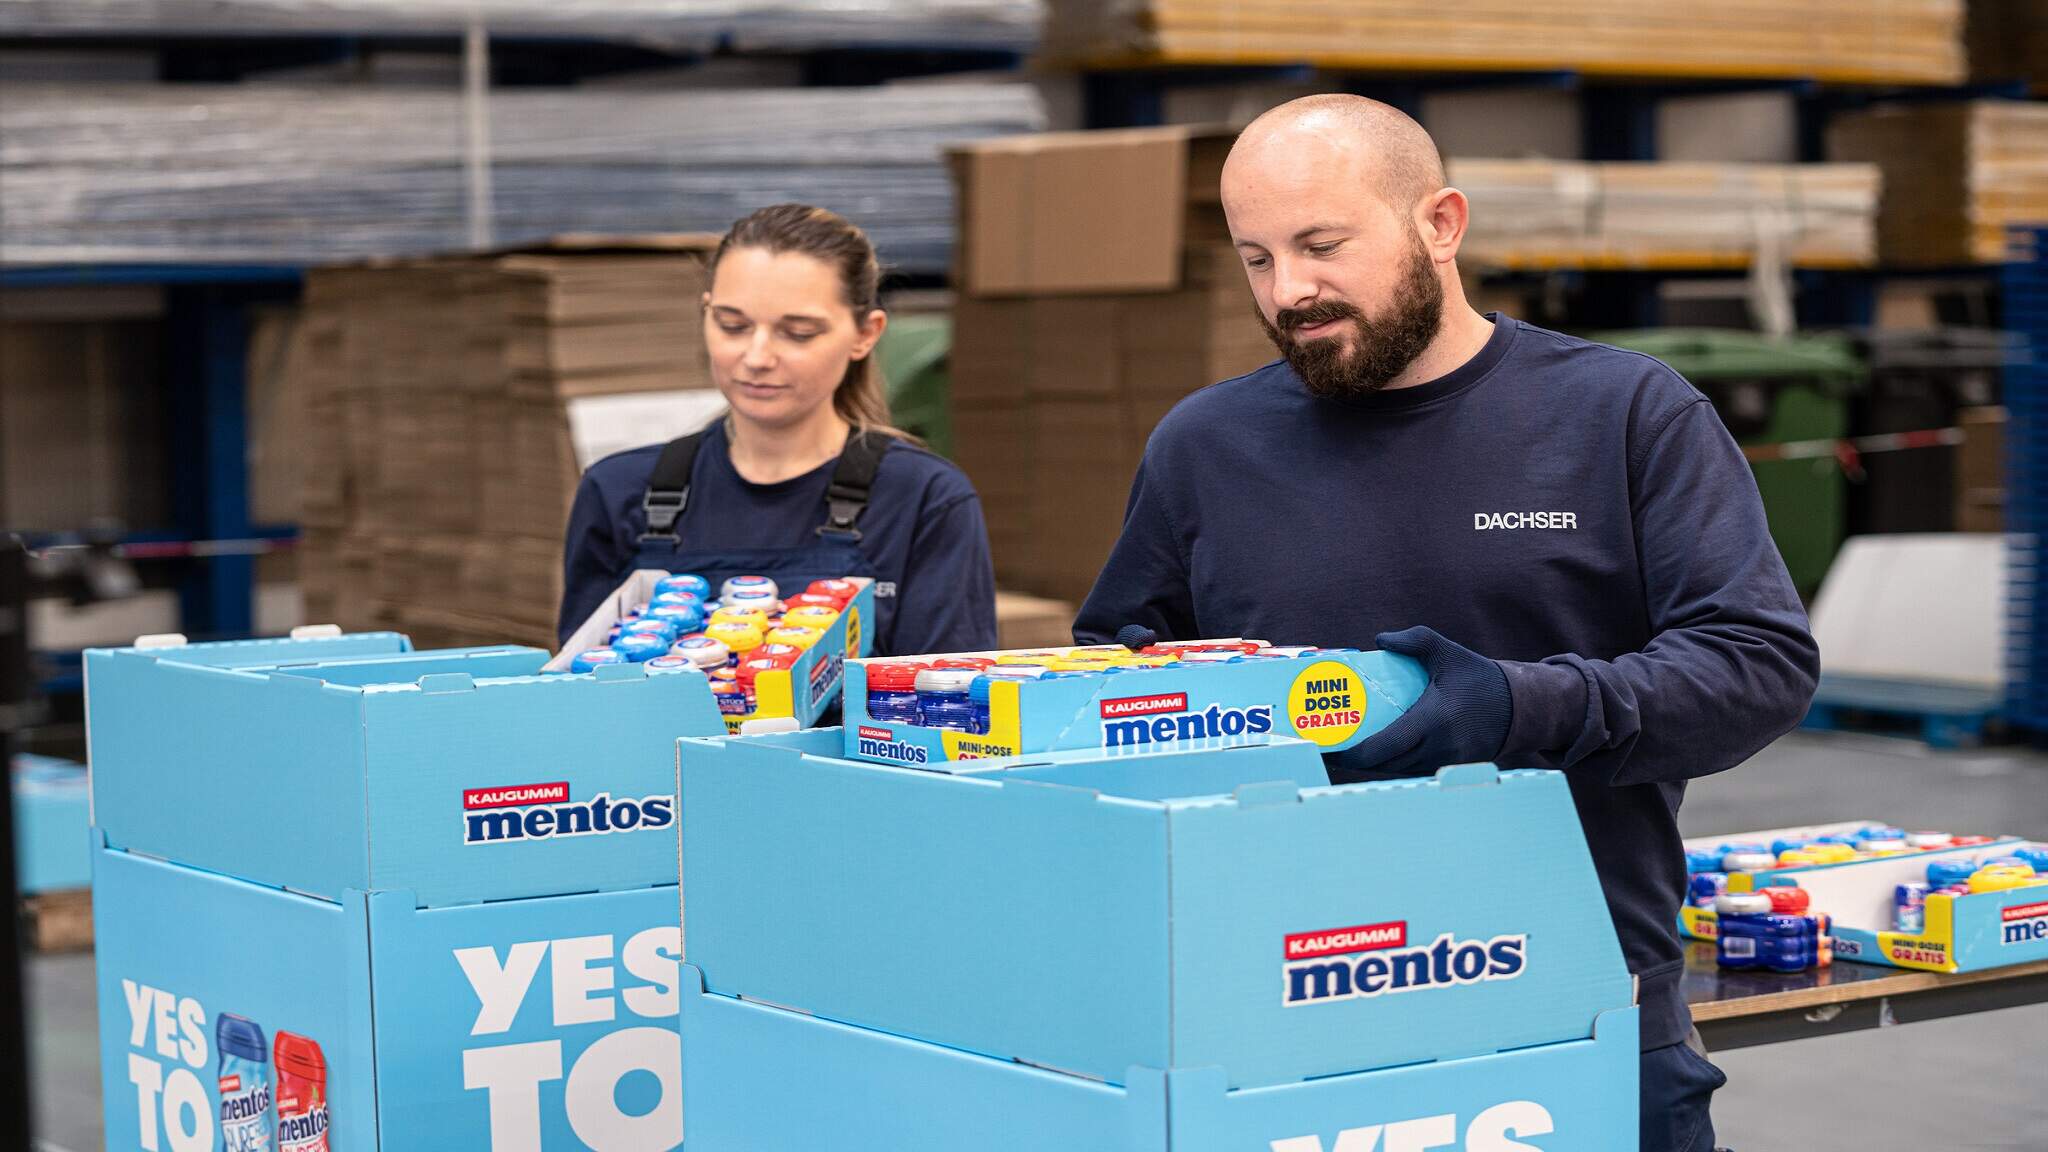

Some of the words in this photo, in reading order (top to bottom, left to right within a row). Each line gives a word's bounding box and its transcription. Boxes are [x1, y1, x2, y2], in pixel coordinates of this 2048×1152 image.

[1474, 511, 1577, 530] DACHSER
[1306, 678, 1348, 694] MINI
[1105, 697, 1182, 714] KAUGUMMI
[1305, 695, 1351, 711] DOSE
[1105, 705, 1272, 747] mentos
[1295, 711, 1360, 729] GRATIS
[860, 739, 926, 763] mentos
[958, 741, 1012, 756] MINI-DOSE
[468, 786, 564, 805] KAUGUMMI
[467, 796, 673, 842] mentos
[1289, 926, 1401, 954] KAUGUMMI
[1892, 948, 1945, 964] GRATIS
[452, 926, 681, 1036] YES
[1288, 938, 1522, 1002] mentos
[122, 979, 208, 1069] YES
[463, 1026, 683, 1152] TO
[128, 1052, 214, 1152] TO
